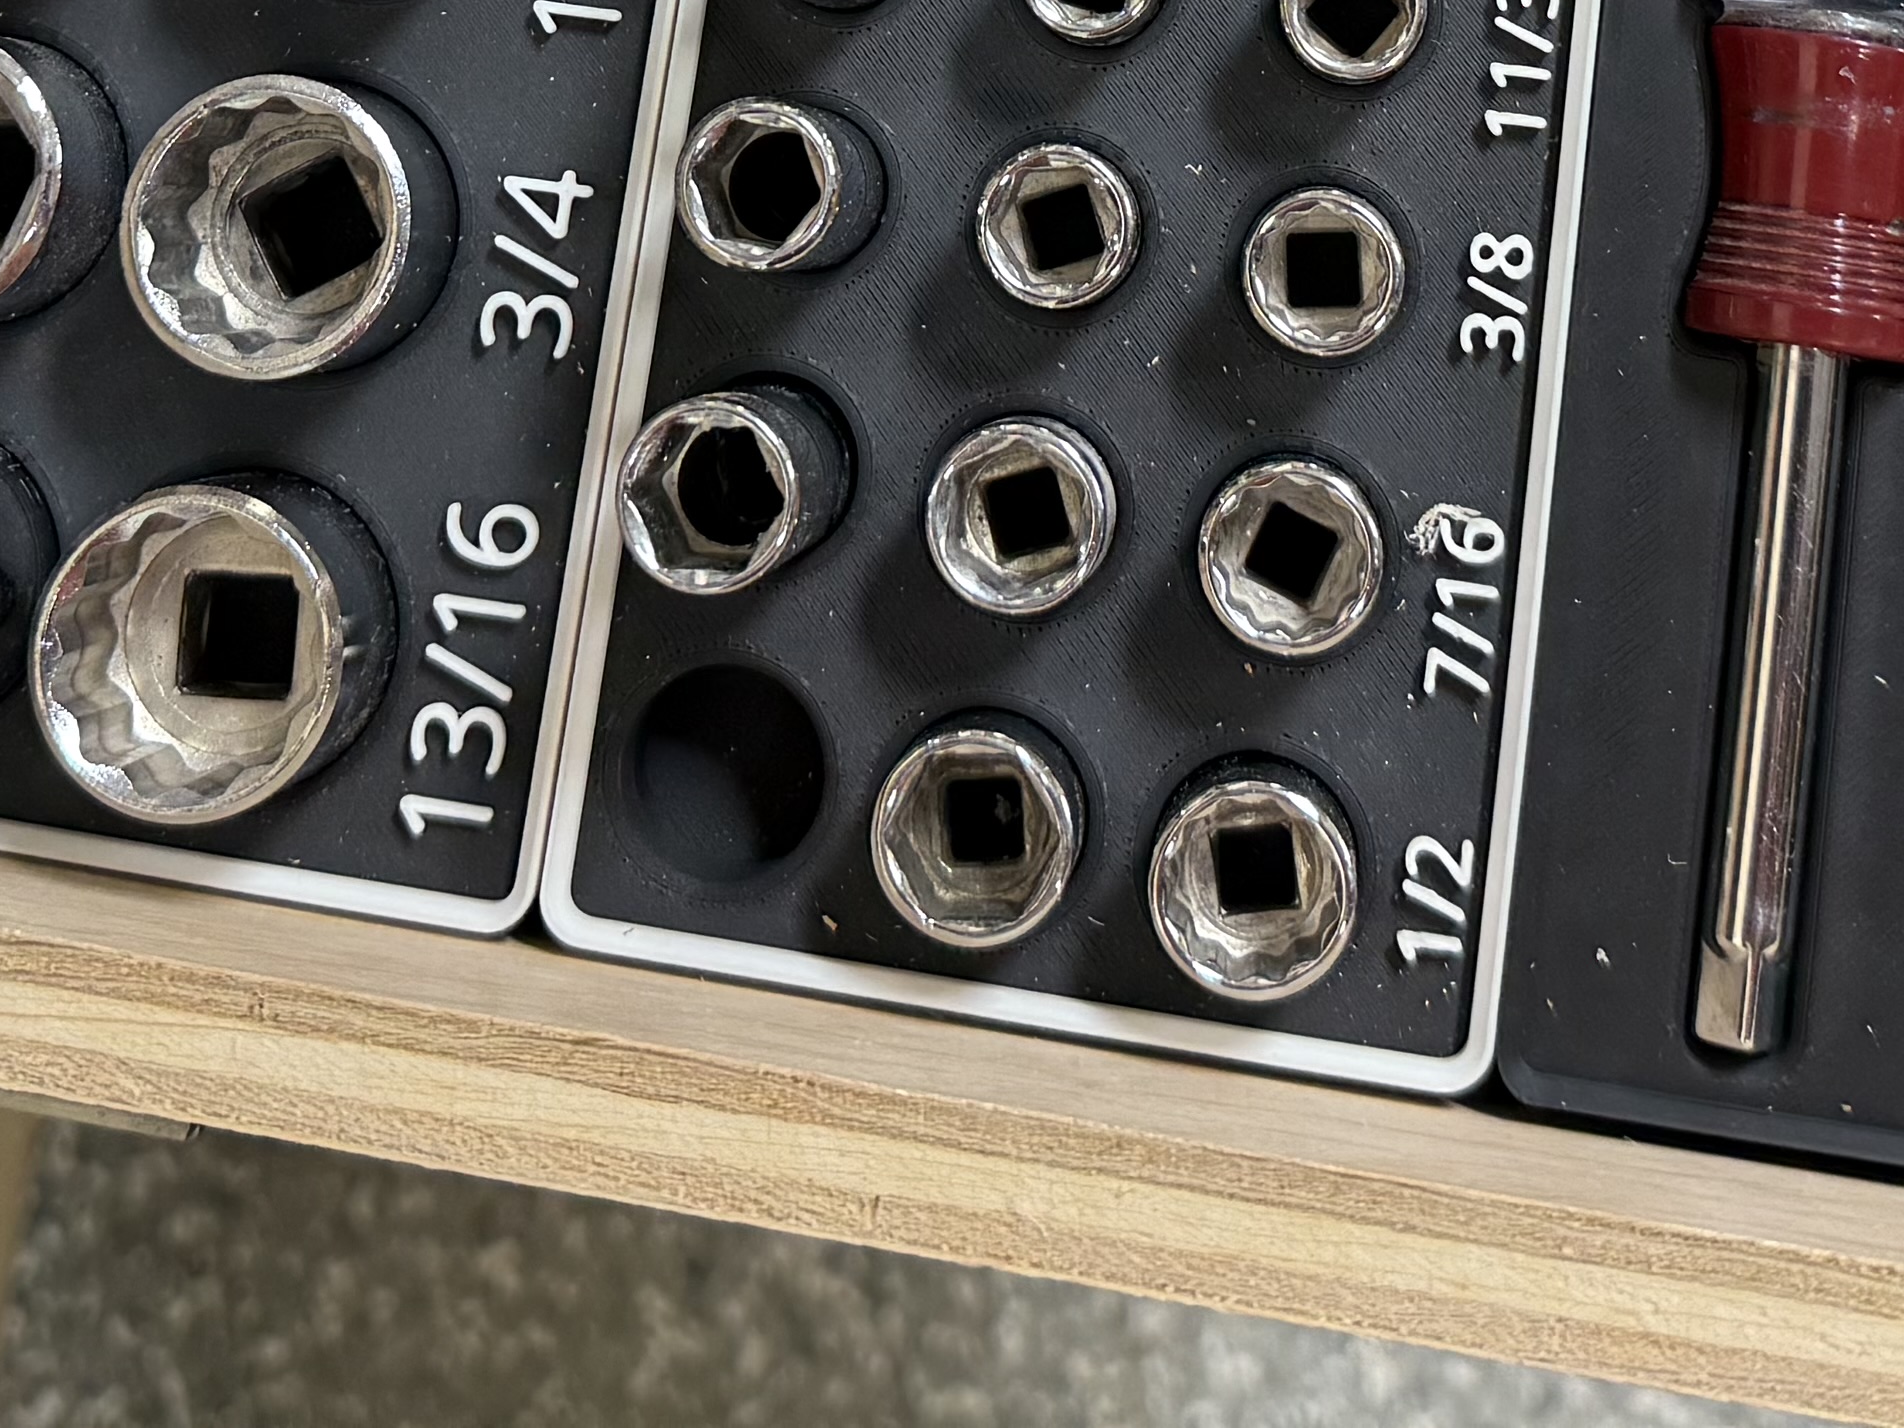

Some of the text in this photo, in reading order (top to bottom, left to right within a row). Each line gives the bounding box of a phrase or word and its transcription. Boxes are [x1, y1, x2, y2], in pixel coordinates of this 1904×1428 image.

[479, 169, 594, 359] 3/4
[1459, 231, 1535, 363] 3/8
[399, 501, 540, 837] 13/16
[1421, 513, 1507, 698] 7/16
[1396, 835, 1475, 963] 1/2
